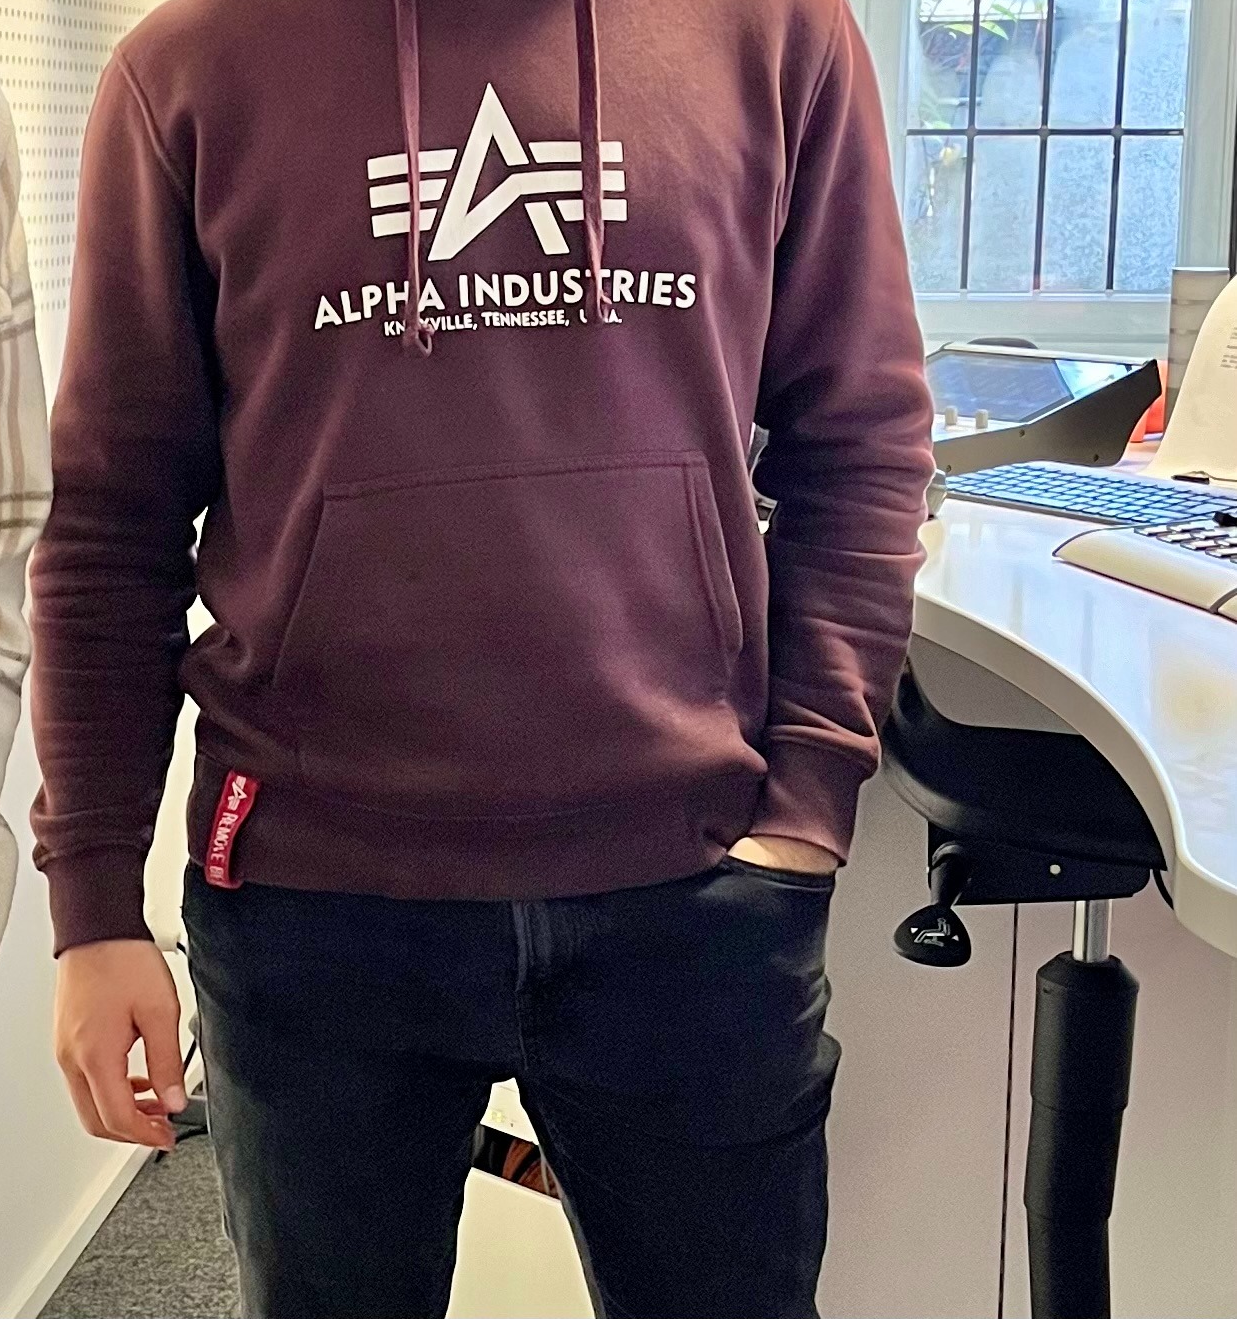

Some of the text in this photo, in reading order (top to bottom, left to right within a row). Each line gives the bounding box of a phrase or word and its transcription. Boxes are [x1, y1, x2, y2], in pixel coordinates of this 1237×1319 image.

[314, 268, 697, 330] ALPHA INDUSTRIES
[481, 309, 570, 328] TENNESSEE,
